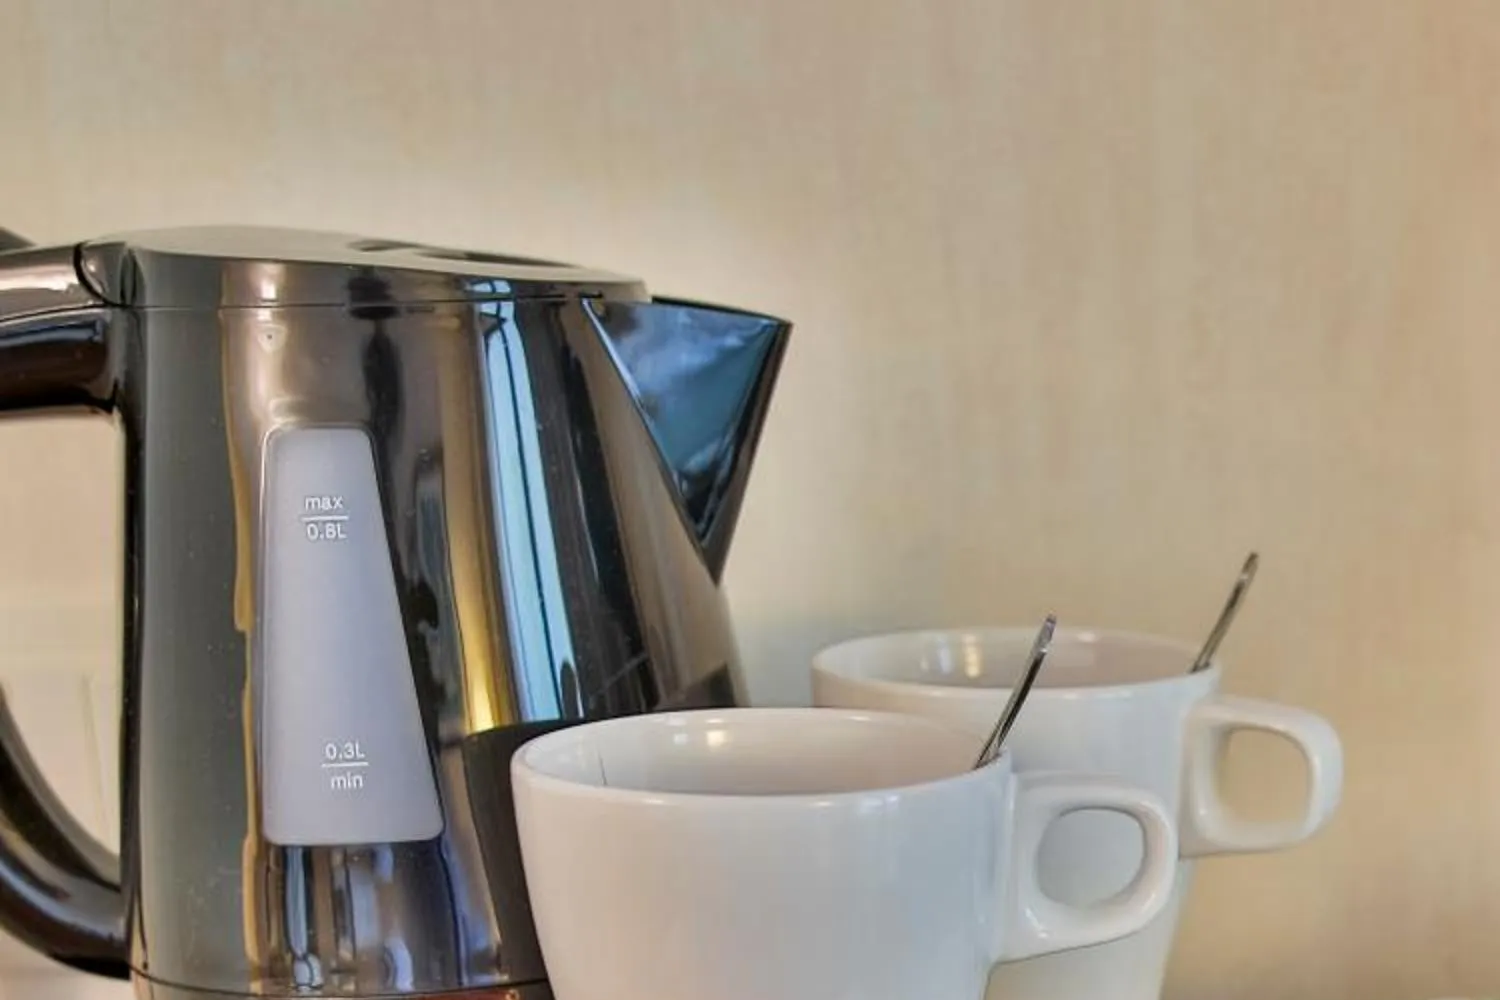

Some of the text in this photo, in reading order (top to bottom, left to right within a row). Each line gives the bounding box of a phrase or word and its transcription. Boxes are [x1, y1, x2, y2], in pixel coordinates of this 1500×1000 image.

[304, 495, 344, 511] max
[306, 522, 347, 541] 0.8L
[324, 743, 366, 760] 0.3L
[330, 773, 363, 789] min
